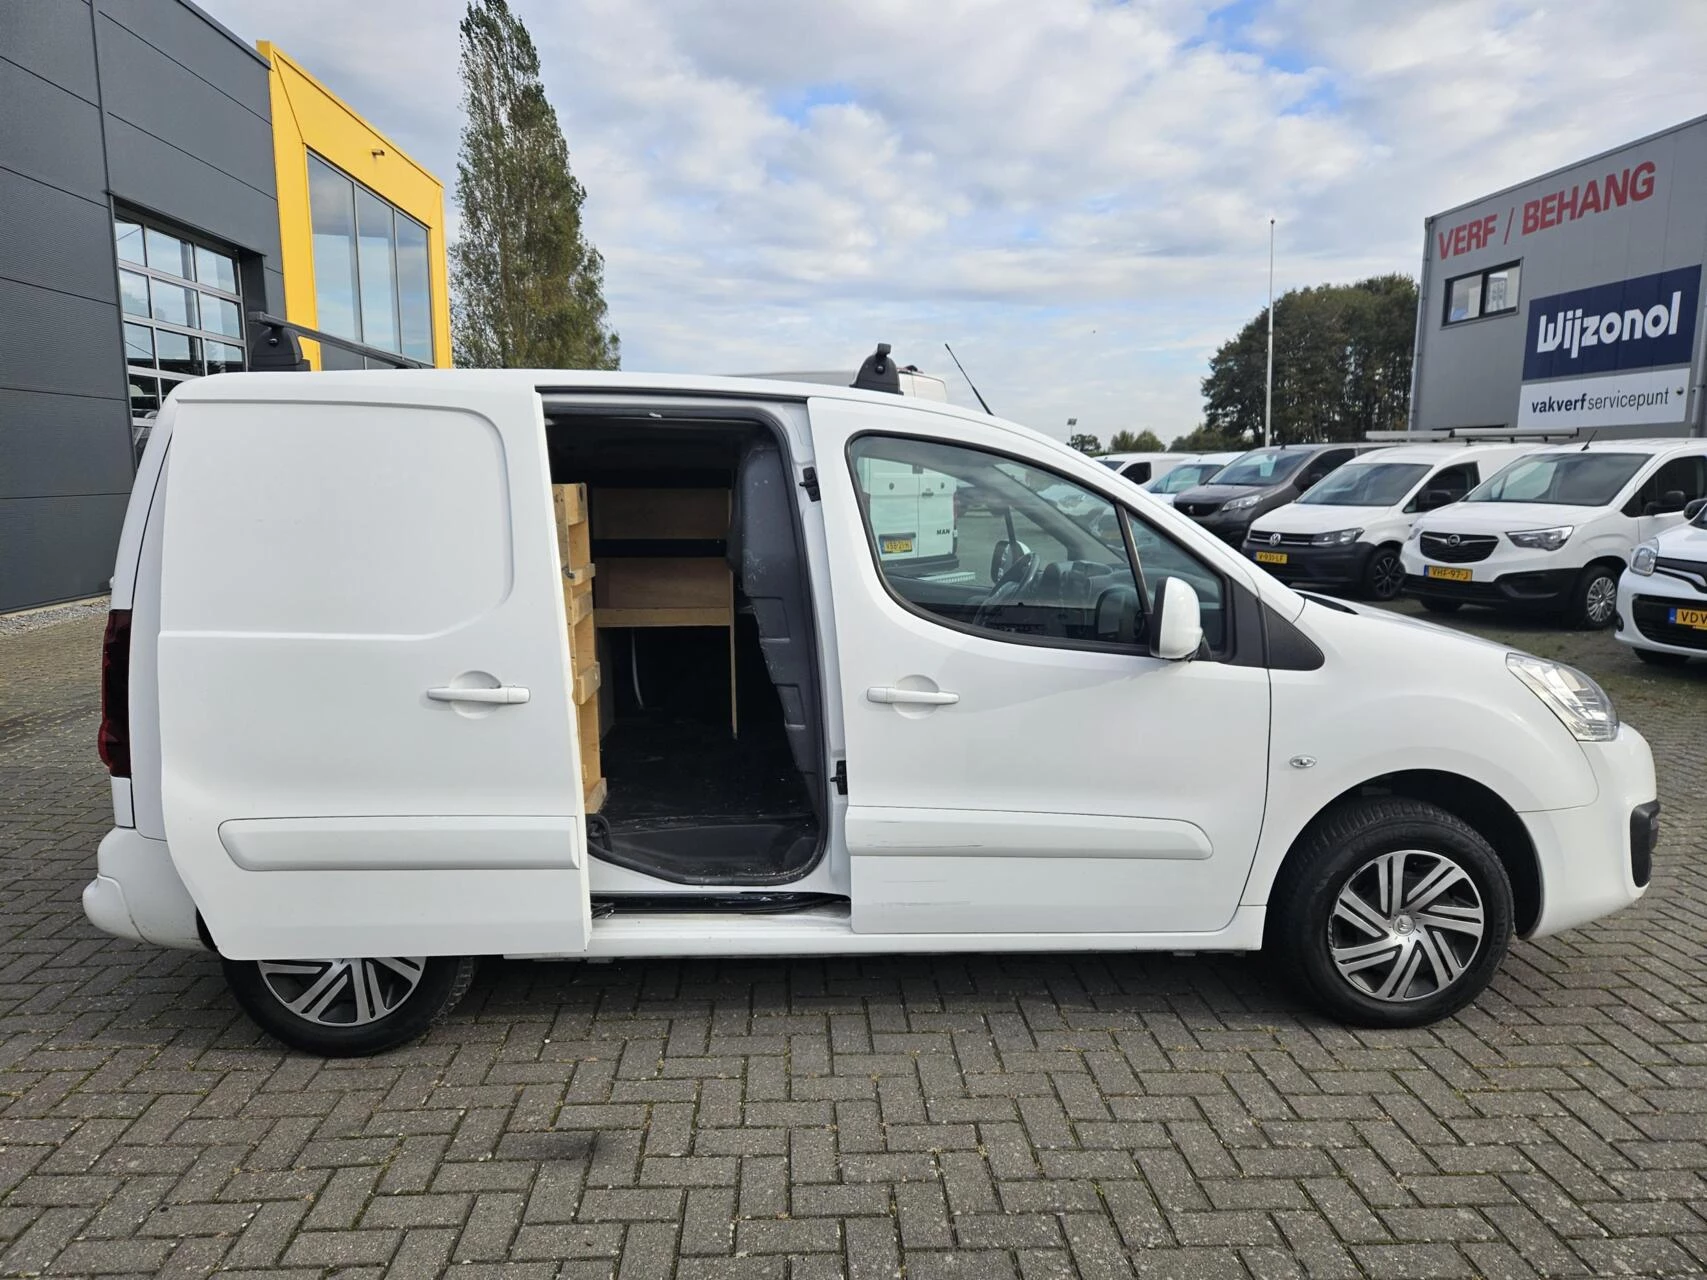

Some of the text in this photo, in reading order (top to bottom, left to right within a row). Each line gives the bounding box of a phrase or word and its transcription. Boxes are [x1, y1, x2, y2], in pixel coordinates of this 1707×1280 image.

[1438, 161, 1656, 260] VERF / BEHANG
[1537, 291, 1682, 359] Wijzonol
